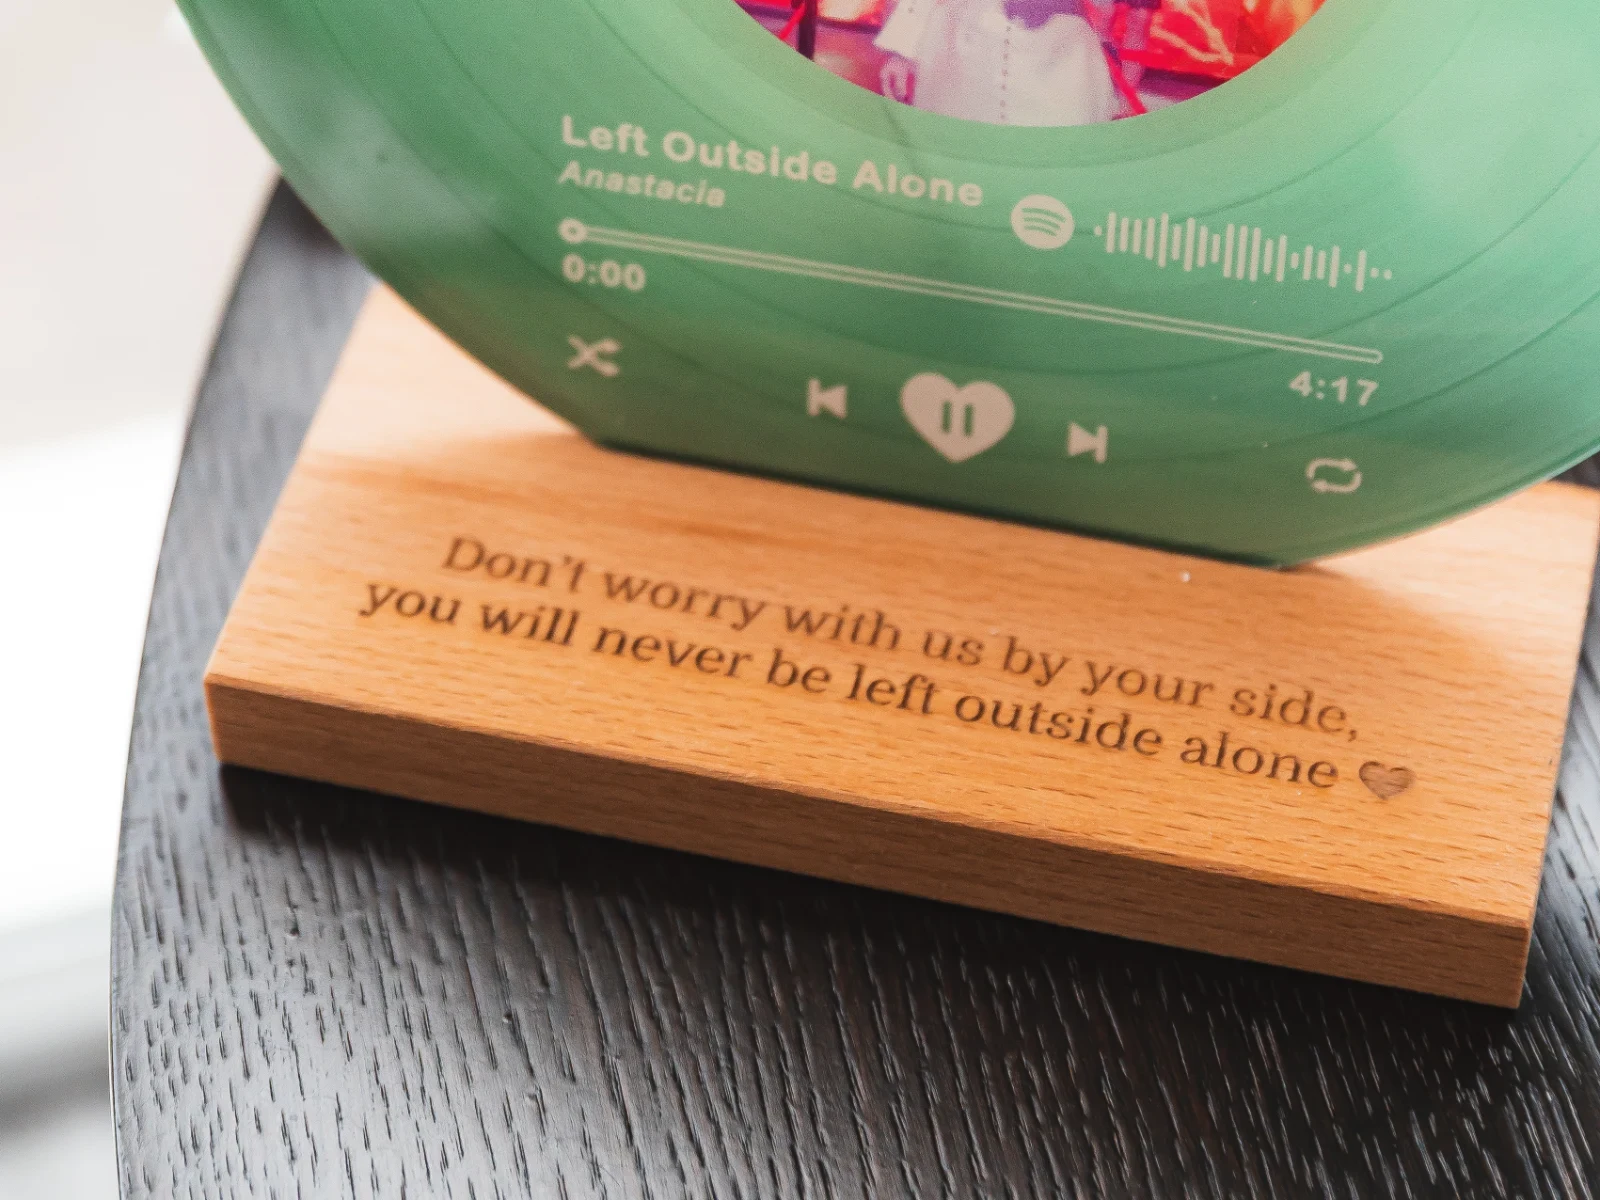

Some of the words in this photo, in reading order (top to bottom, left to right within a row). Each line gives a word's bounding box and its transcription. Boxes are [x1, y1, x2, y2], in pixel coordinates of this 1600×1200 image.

[558, 160, 727, 209] Anastacia
[561, 114, 650, 158] Left
[662, 131, 838, 185] Outside
[851, 160, 985, 207] Alone
[562, 253, 647, 292] 0:00
[1289, 371, 1379, 406] 4:17
[441, 536, 588, 594] Don't
[601, 569, 767, 631] worry
[783, 605, 900, 652] with
[922, 629, 985, 667] us
[1002, 635, 1070, 688] by
[1079, 660, 1215, 709] your
[1228, 683, 1360, 743] side,
[359, 581, 462, 626] you
[479, 602, 582, 648] will
[590, 625, 755, 679] never
[766, 648, 833, 694] be
[846, 663, 940, 715] left
[954, 693, 1164, 757] outside
[1179, 730, 1340, 790] alone
